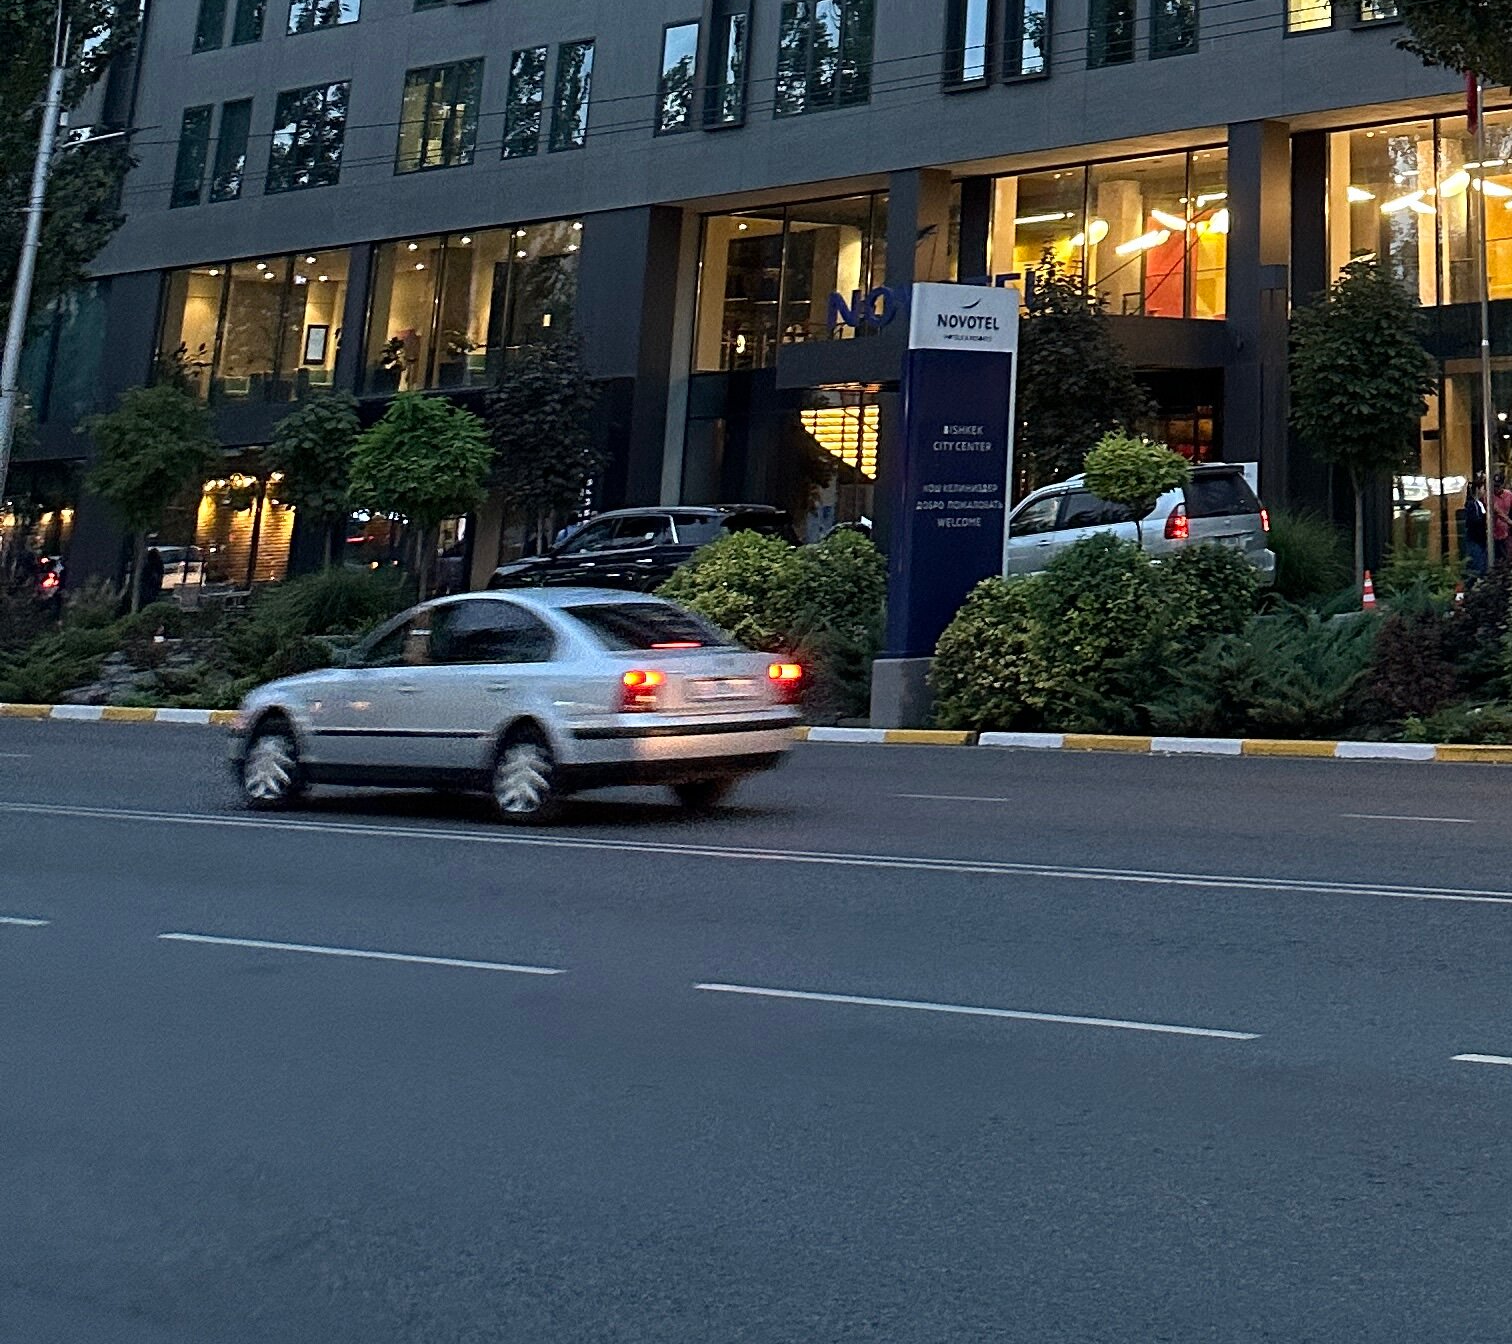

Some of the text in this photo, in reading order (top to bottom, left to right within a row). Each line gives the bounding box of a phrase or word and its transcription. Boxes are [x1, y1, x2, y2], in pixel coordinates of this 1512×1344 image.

[937, 314, 999, 330] NOVOTEL
[943, 425, 984, 435] BISHKEK
[933, 441, 992, 451] CITY CENTER
[937, 517, 982, 527] WELCOME
